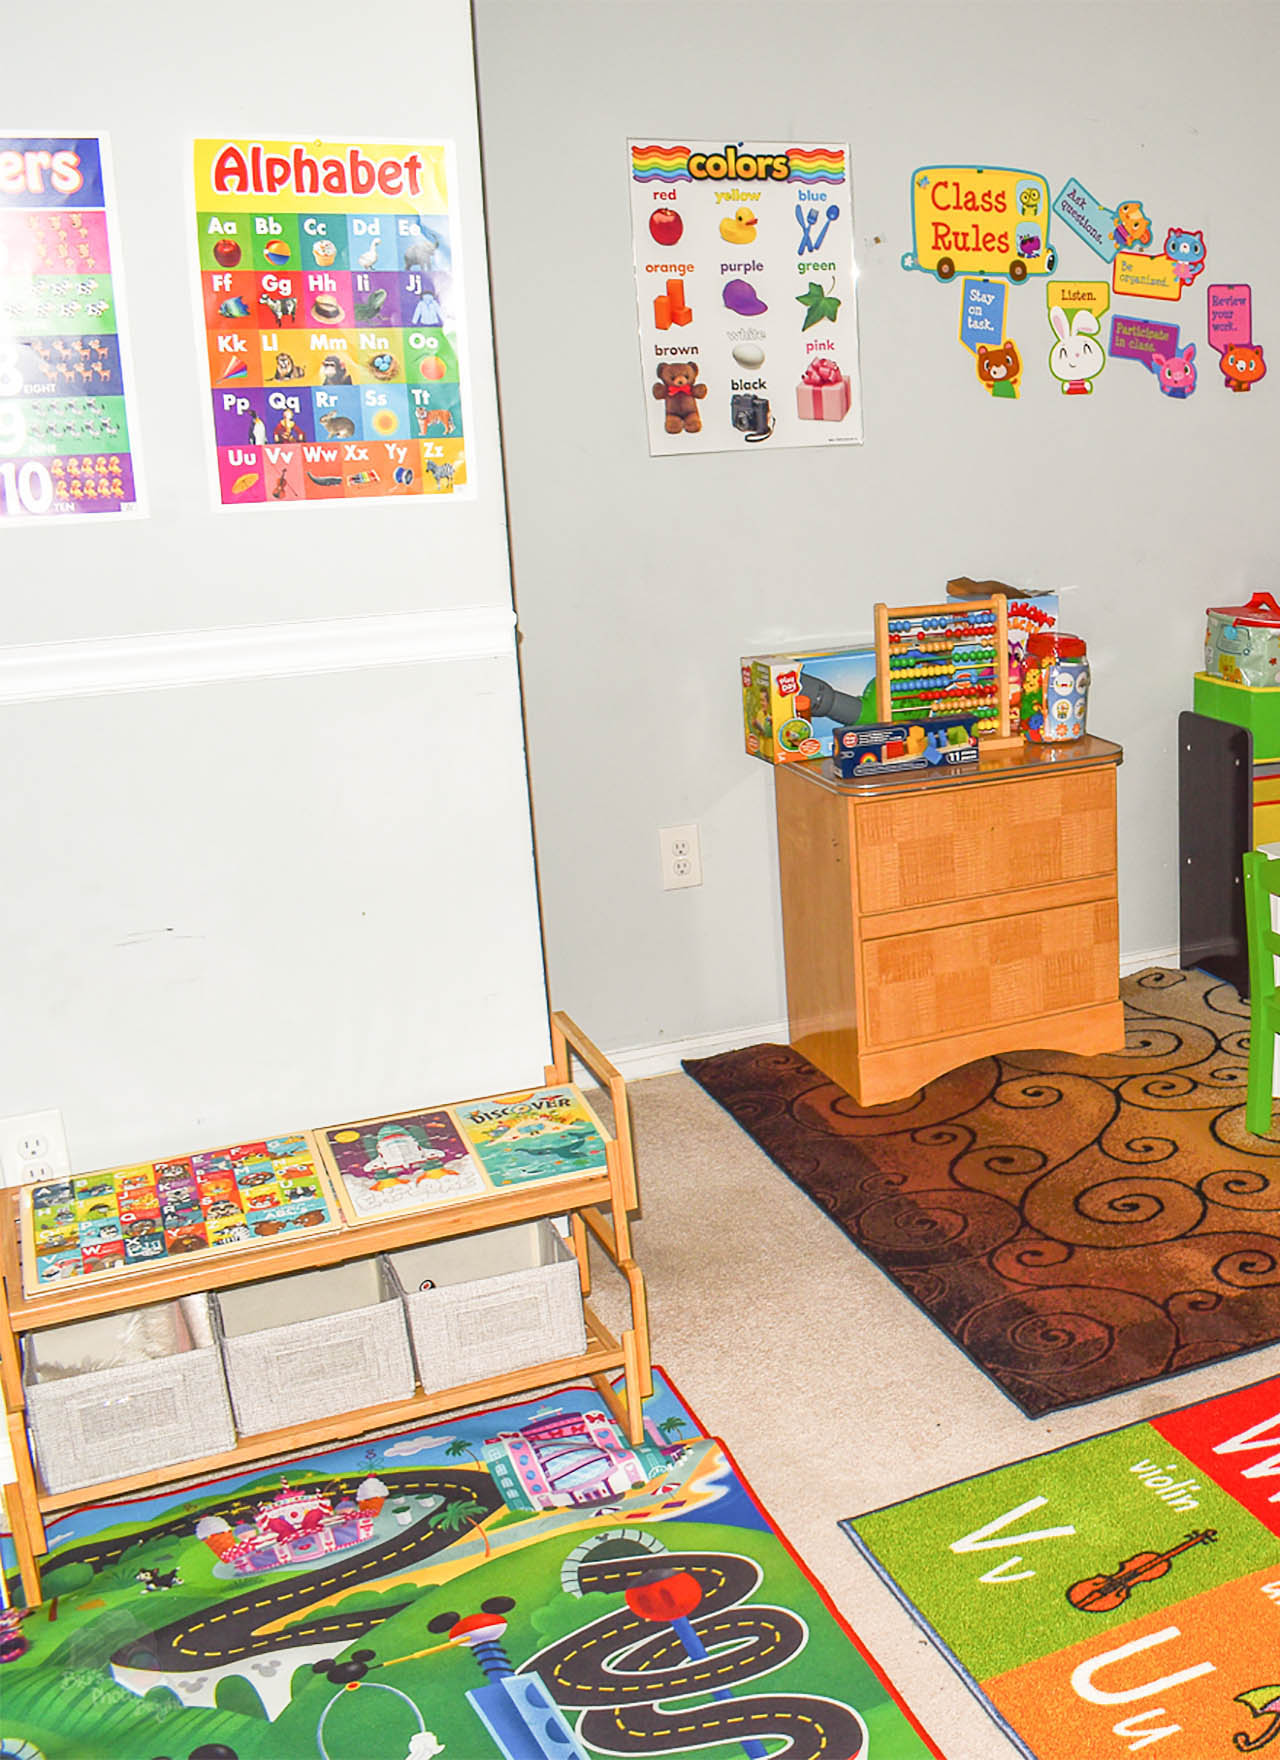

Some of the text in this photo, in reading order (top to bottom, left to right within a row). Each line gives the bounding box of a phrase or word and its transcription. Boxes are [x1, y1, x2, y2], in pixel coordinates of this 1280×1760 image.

[213, 146, 422, 195] Alphabet
[688, 145, 790, 180] colors
[653, 189, 827, 203] red yellow blue
[931, 181, 1007, 213] Class
[1067, 189, 1087, 210] Ask
[208, 218, 421, 236] Aa Bb Cc Dd Ee
[1061, 200, 1102, 244] questions.
[932, 222, 1010, 253] Rules
[646, 261, 836, 275] orange purple green
[1121, 261, 1133, 271] Be
[213, 275, 422, 296] Ff Gg Hh Ii Jj
[969, 289, 995, 305] Stay
[1061, 290, 1096, 301] Listen.
[1212, 296, 1246, 306] Review
[968, 306, 982, 316] on
[1212, 310, 1233, 320] your
[968, 316, 994, 331] task.
[726, 328, 766, 341] white
[1116, 323, 1169, 341] Participate
[218, 334, 438, 353] Kk Ll Mm Nn Oo
[655, 345, 699, 356] brown
[806, 340, 834, 354] pink
[1115, 336, 1156, 352] in class.
[24, 384, 56, 393] EIGHT
[731, 378, 766, 391] black
[223, 389, 429, 415] Pp Qq Rr Ss Tt
[229, 443, 443, 466] Uu Vv Ww Xx Yy Zz
[0, 461, 53, 515] 10
[54, 502, 75, 512] TEN
[949, 751, 960, 762] 11
[470, 1098, 571, 1124] DISCOVER
[1129, 1457, 1201, 1514] violin
